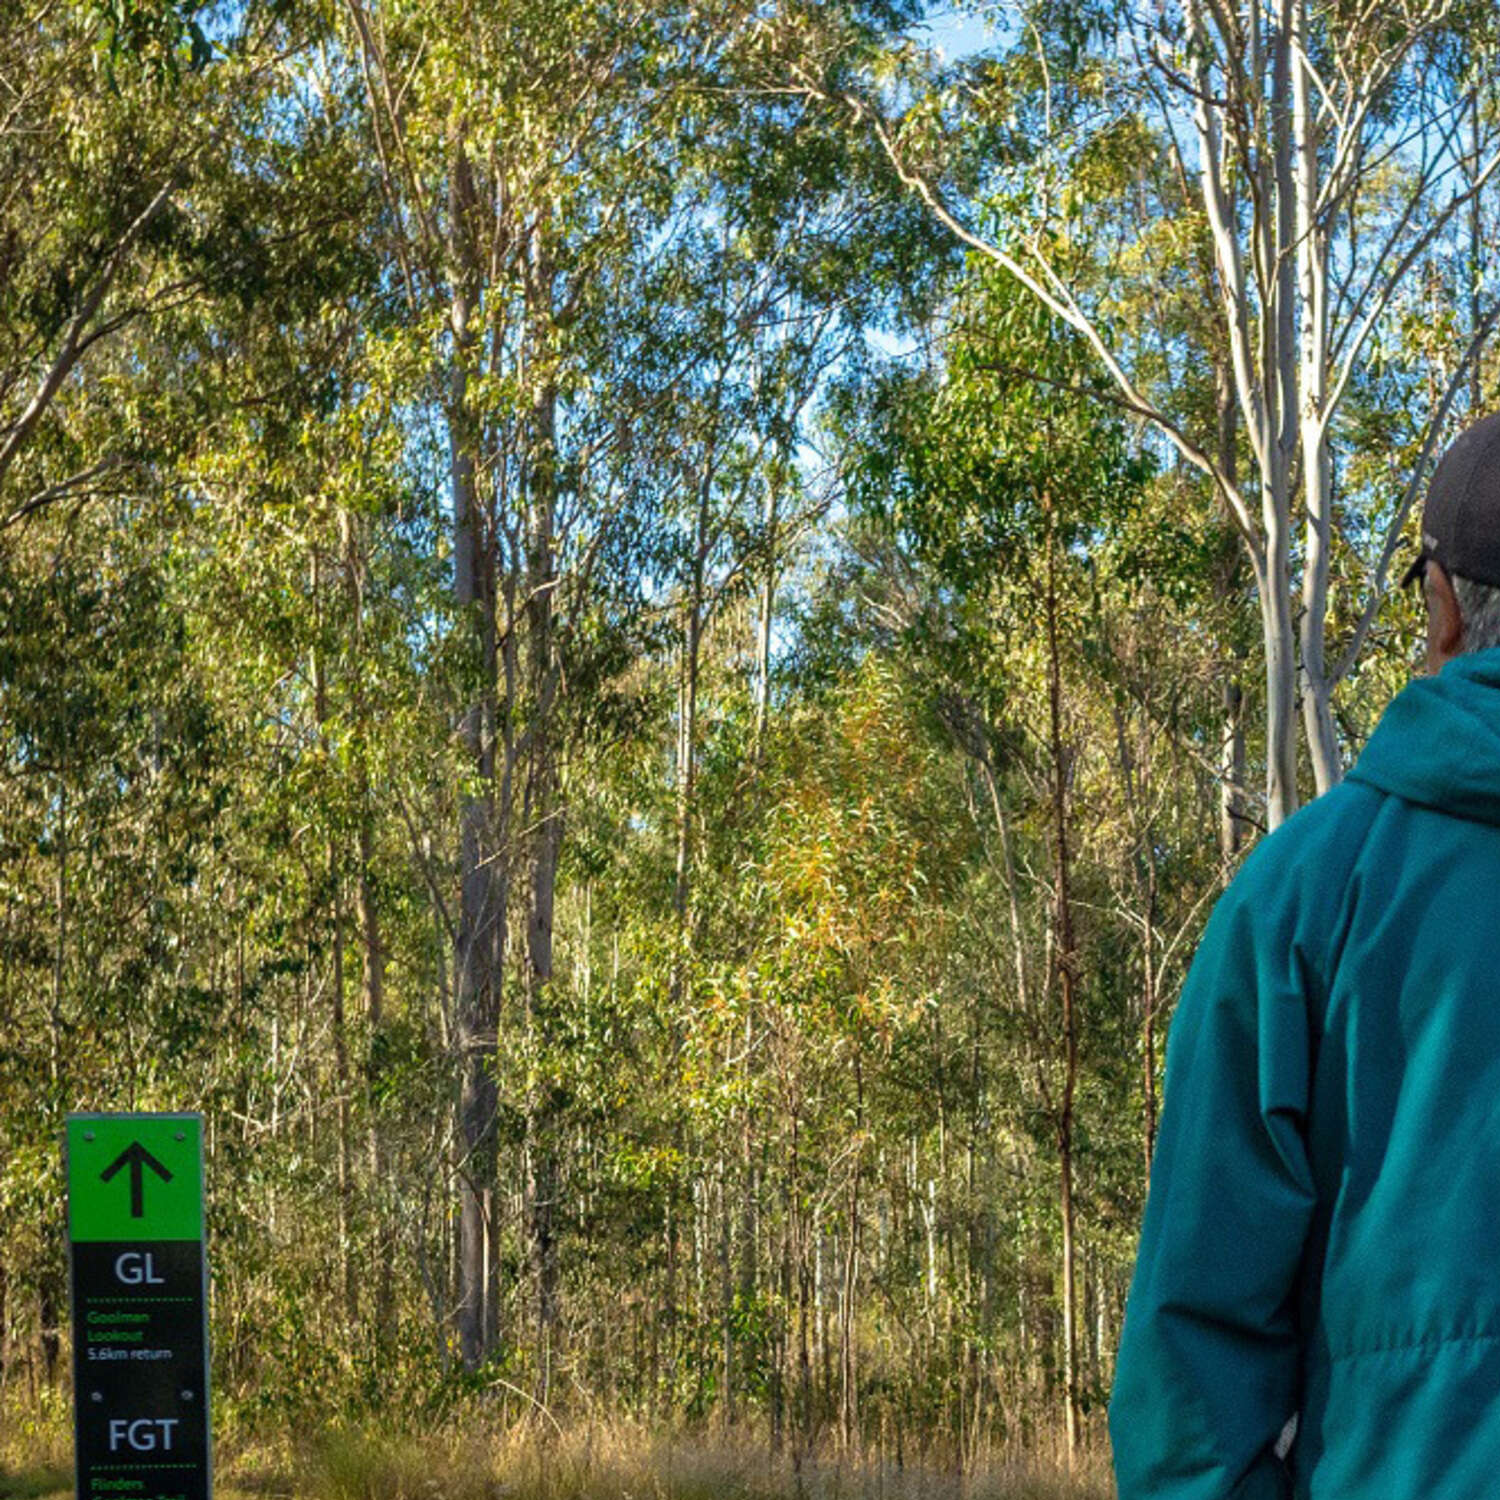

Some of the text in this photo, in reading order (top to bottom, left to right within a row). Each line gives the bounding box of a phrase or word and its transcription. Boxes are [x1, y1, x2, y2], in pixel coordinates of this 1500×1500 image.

[115, 1252, 165, 1284] GL
[87, 1347, 173, 1360] 5.6km return
[109, 1418, 179, 1450] FGT
